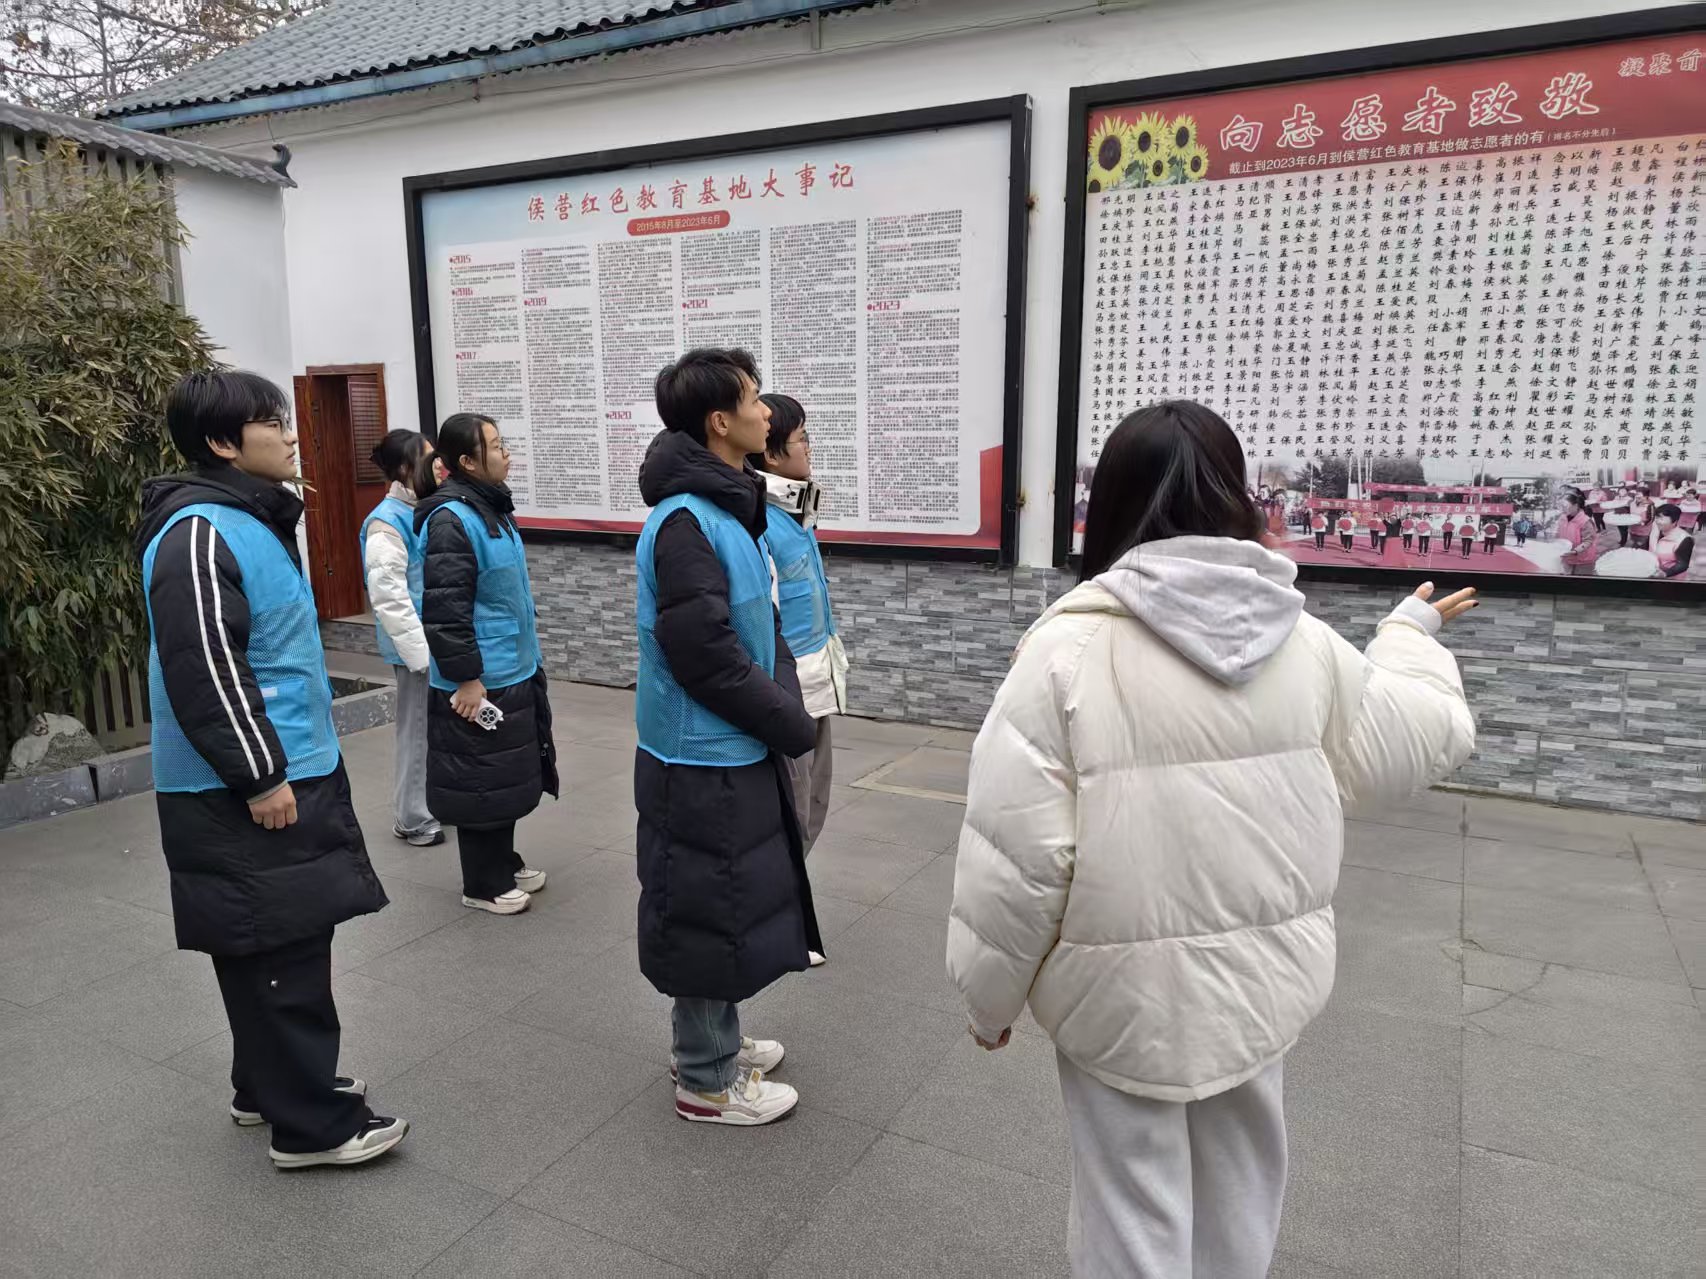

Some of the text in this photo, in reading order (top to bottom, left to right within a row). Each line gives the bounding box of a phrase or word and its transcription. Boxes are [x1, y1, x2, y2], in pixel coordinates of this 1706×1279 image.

[1220, 72, 1600, 153] 向志愿者致敬
[528, 162, 855, 220] 侯营红色教育基地大事记
[636, 215, 721, 232] 2015年8月至2023年6月
[452, 255, 472, 264] 2015
[527, 297, 547, 307] 2019
[686, 298, 708, 309] 2021
[872, 300, 901, 311] 2023
[459, 351, 477, 361] 2017
[608, 410, 632, 421] 2020
